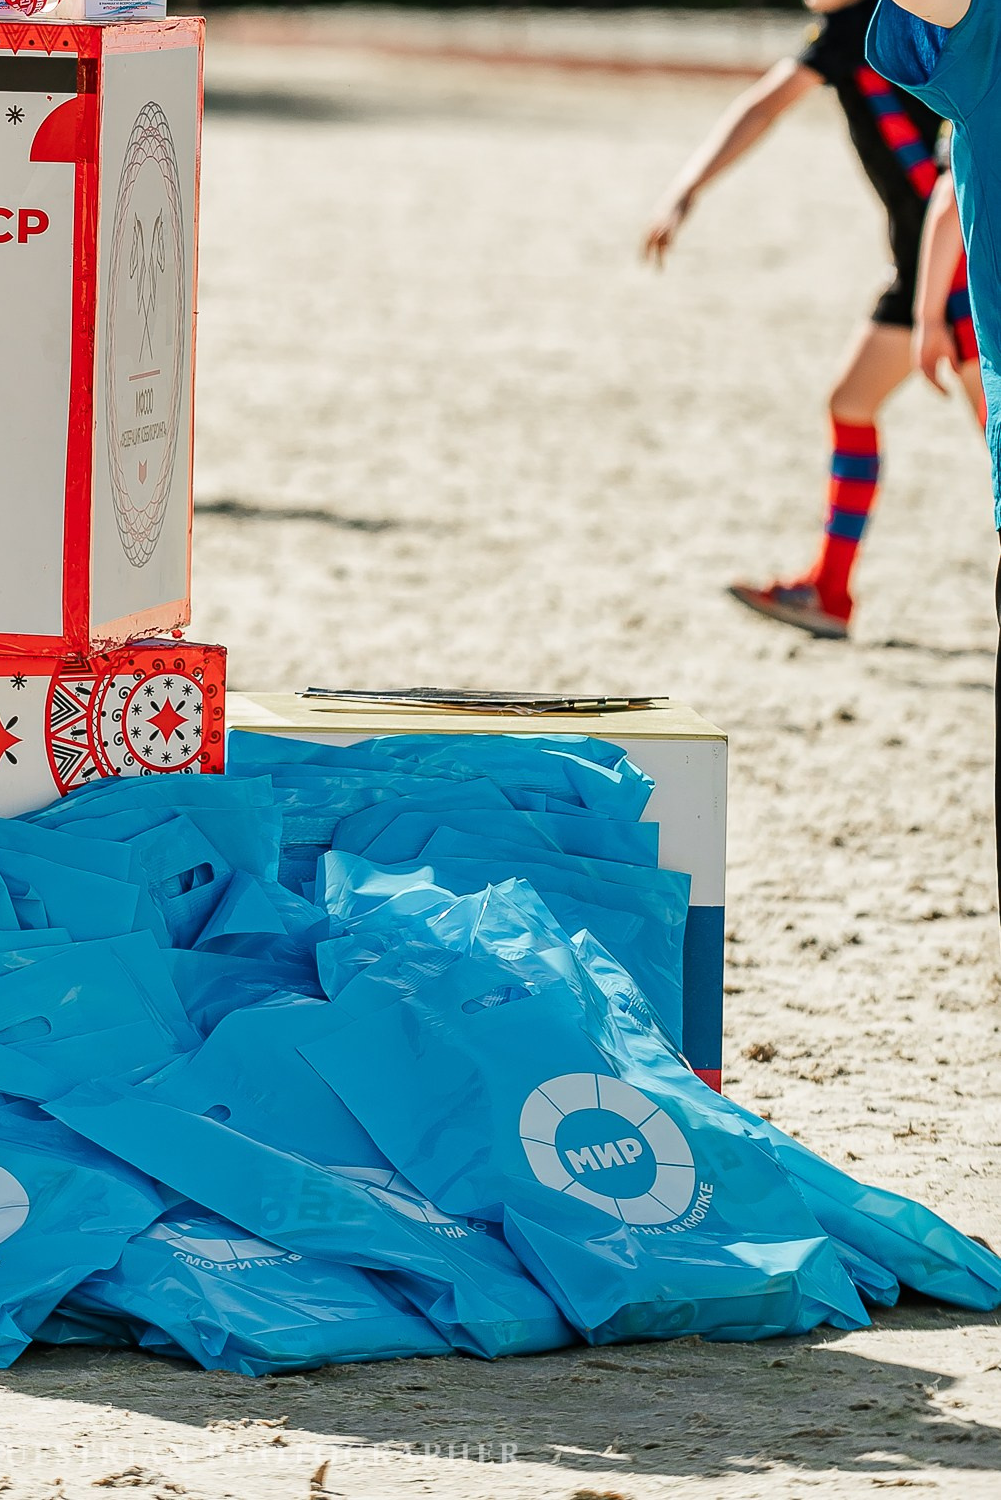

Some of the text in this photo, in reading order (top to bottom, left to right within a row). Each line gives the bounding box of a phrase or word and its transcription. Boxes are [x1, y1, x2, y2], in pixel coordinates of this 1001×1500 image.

[565, 1137, 643, 1174] МИР
[640, 1225, 665, 1237] НА
[665, 1222, 685, 1235] 18
[681, 1180, 714, 1230] КНОПКЕ
[446, 1224, 468, 1239] НА
[171, 1250, 252, 1272] СМОТРИ
[254, 1257, 281, 1270] НА
